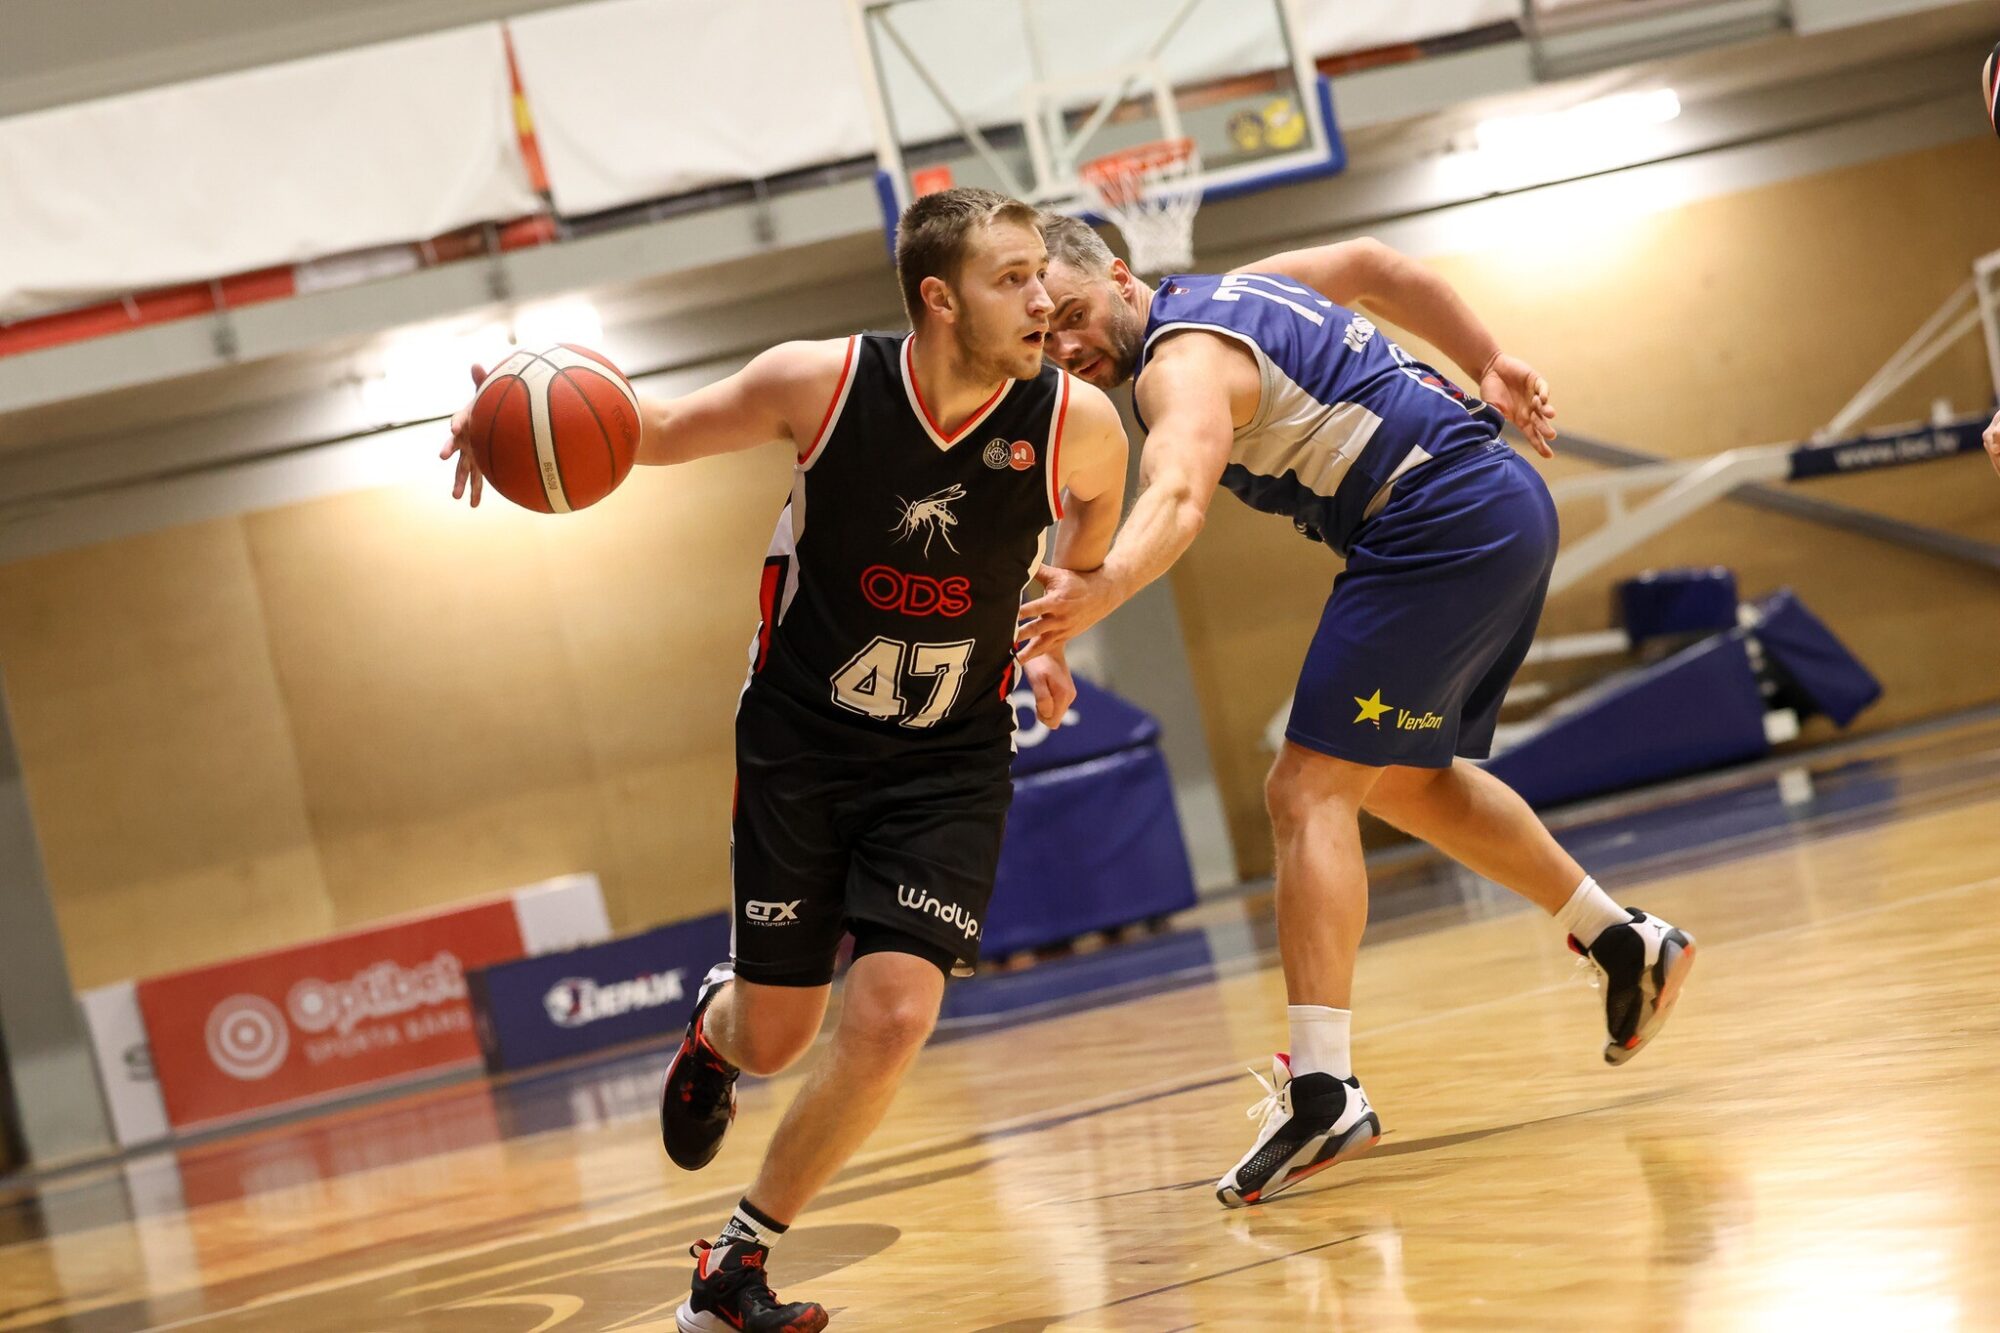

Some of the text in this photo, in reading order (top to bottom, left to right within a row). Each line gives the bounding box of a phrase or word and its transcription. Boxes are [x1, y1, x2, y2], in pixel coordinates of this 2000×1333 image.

[1212, 274, 1332, 327] 77
[860, 564, 973, 618] ODS
[830, 635, 976, 728] 47
[1396, 708, 1444, 731] VerCon
[745, 898, 802, 922] ETX
